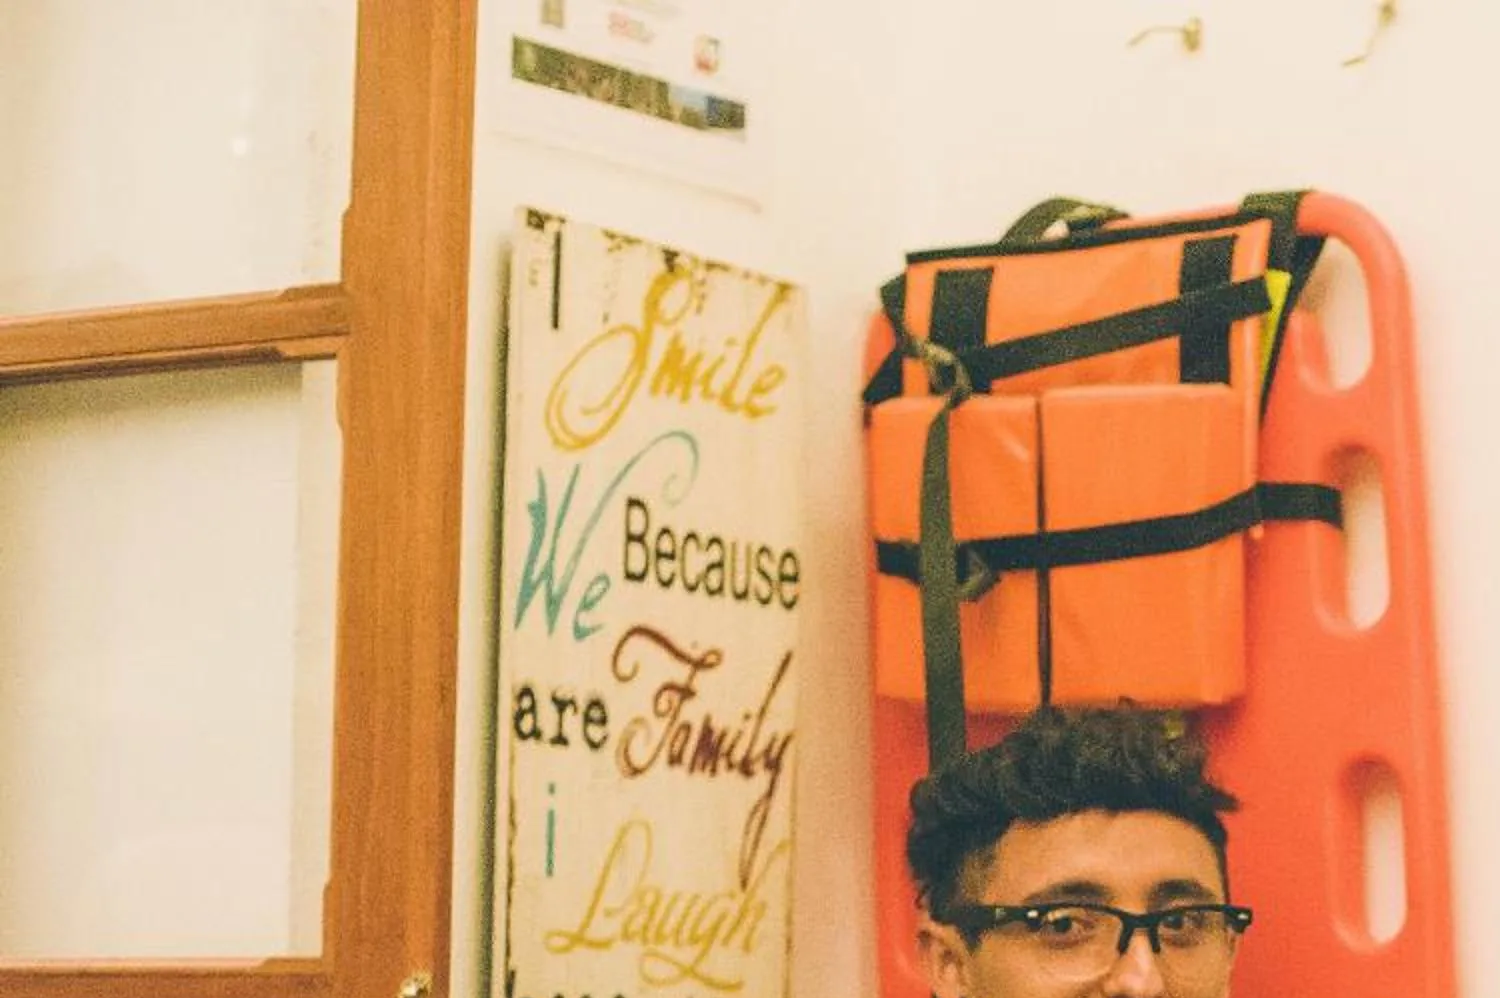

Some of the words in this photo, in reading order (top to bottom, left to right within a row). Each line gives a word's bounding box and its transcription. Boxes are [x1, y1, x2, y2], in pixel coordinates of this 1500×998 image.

[545, 268, 788, 452] Smile
[514, 430, 699, 642] We
[622, 496, 800, 610] Because
[513, 683, 609, 750] are
[612, 625, 793, 892] Family
[544, 819, 791, 991] Laugh
